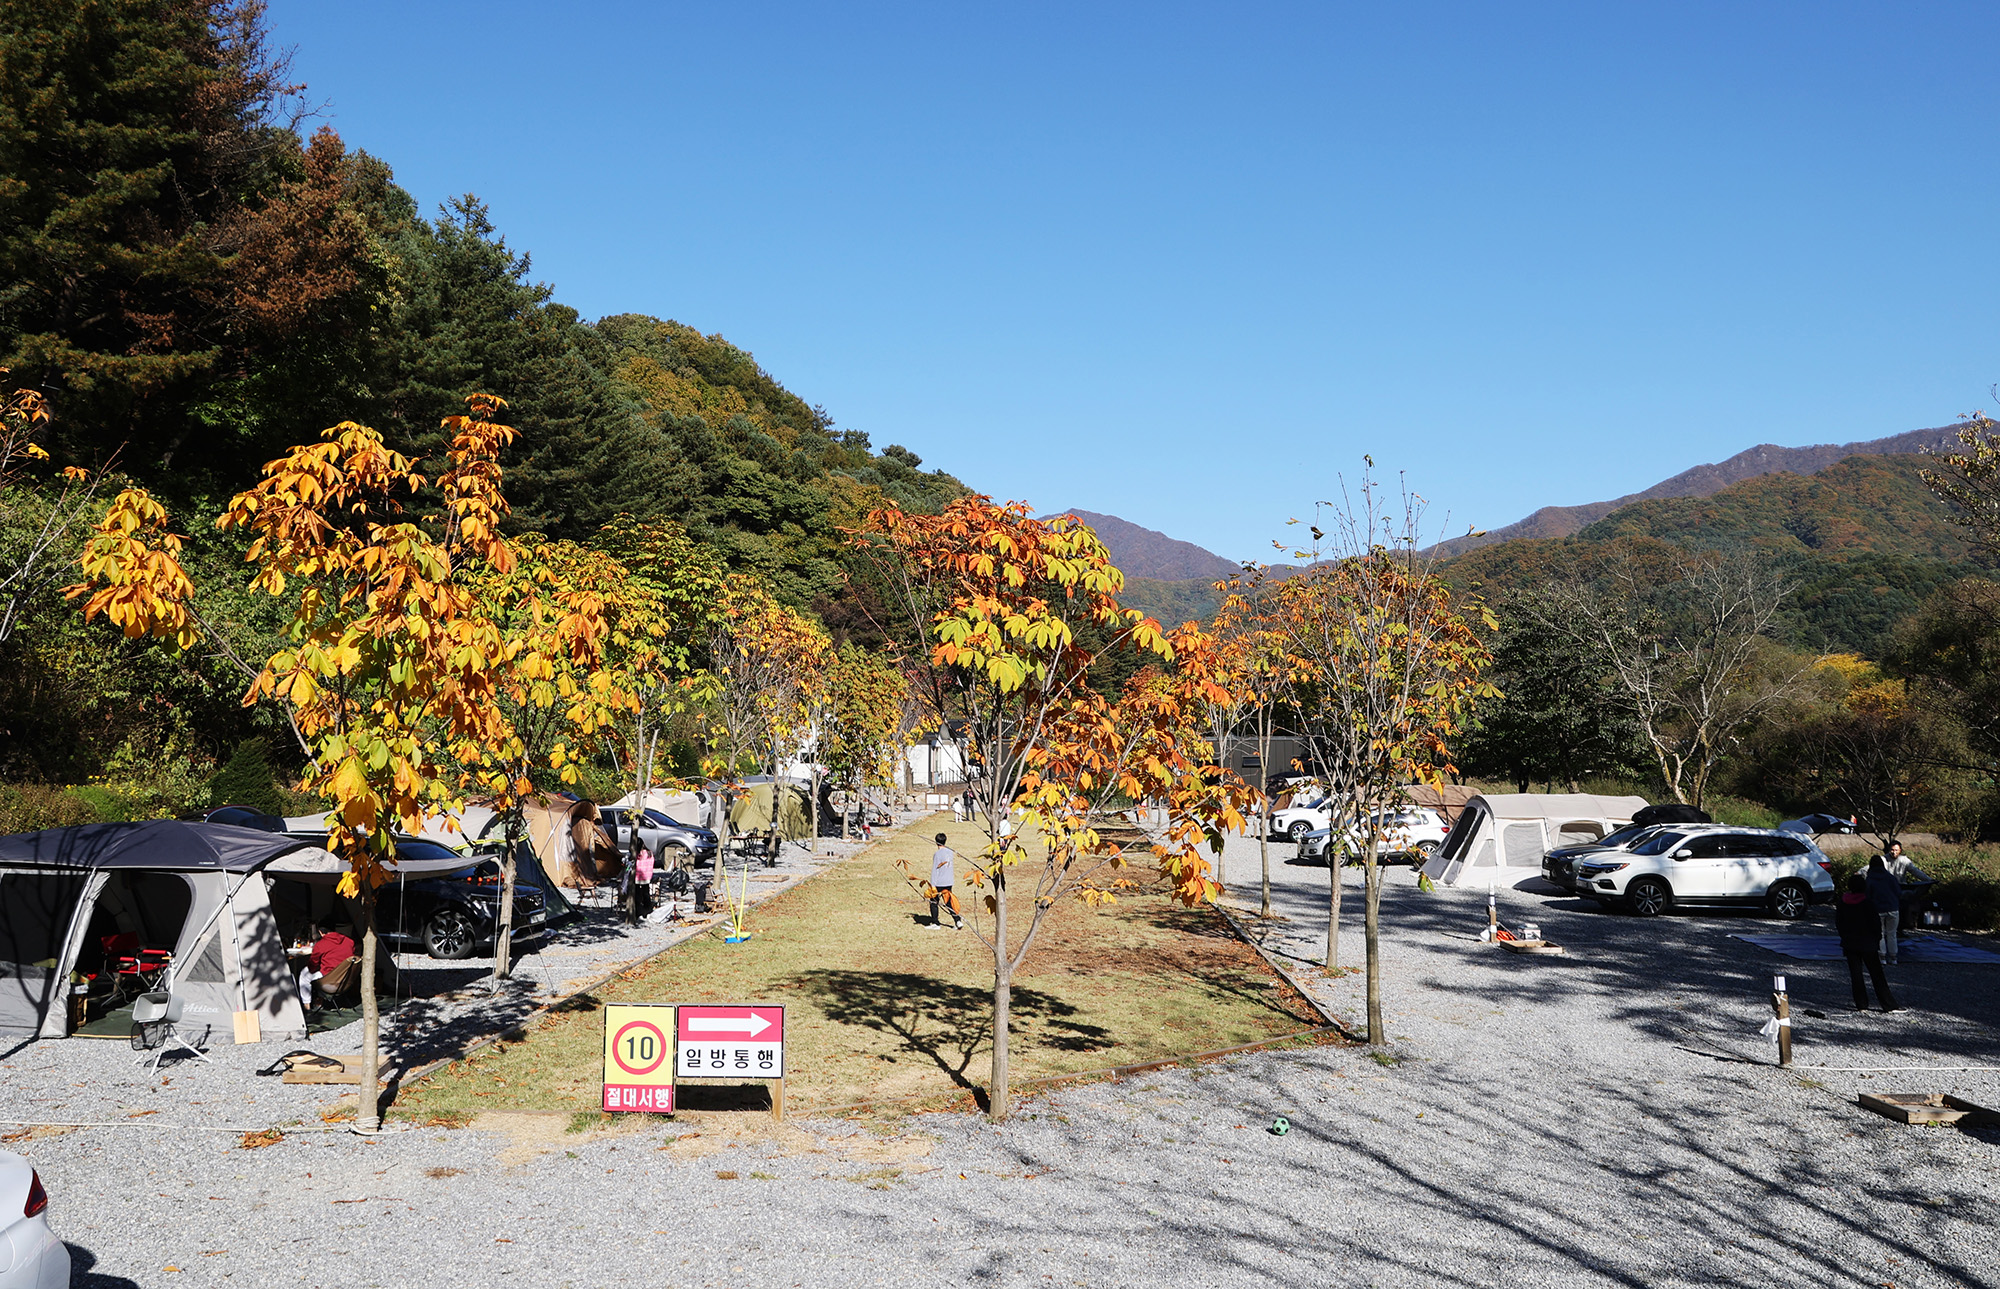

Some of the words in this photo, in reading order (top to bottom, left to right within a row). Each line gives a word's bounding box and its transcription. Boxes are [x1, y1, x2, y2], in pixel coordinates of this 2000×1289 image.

[626, 1036, 654, 1060] 10
[686, 1048, 774, 1069] 일방통행
[607, 1087, 669, 1109] 절대서행
